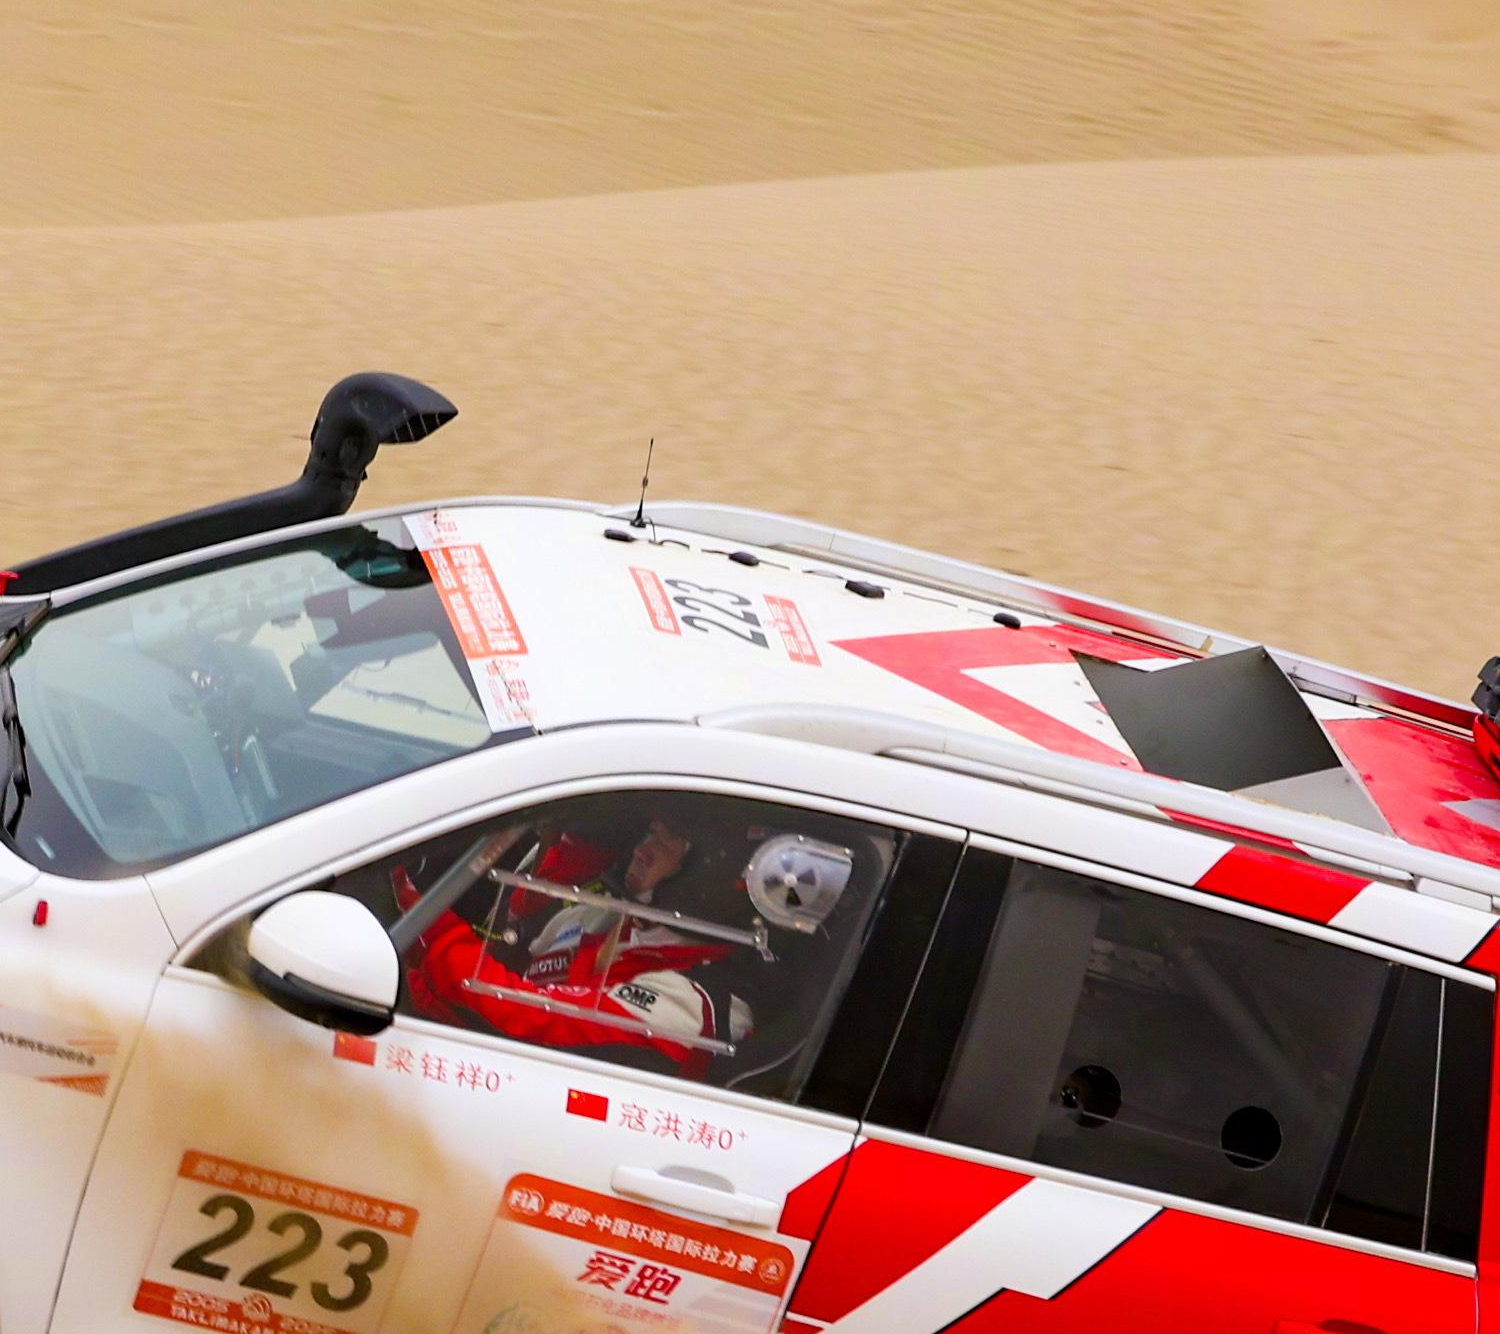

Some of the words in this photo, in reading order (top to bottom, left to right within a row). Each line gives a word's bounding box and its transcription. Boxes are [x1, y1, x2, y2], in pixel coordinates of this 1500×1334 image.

[665, 579, 769, 648] 223
[617, 985, 657, 1008] OMP
[508, 1188, 541, 1212] FIA
[171, 1194, 389, 1312] 223
[577, 1251, 681, 1305] 爱跑
